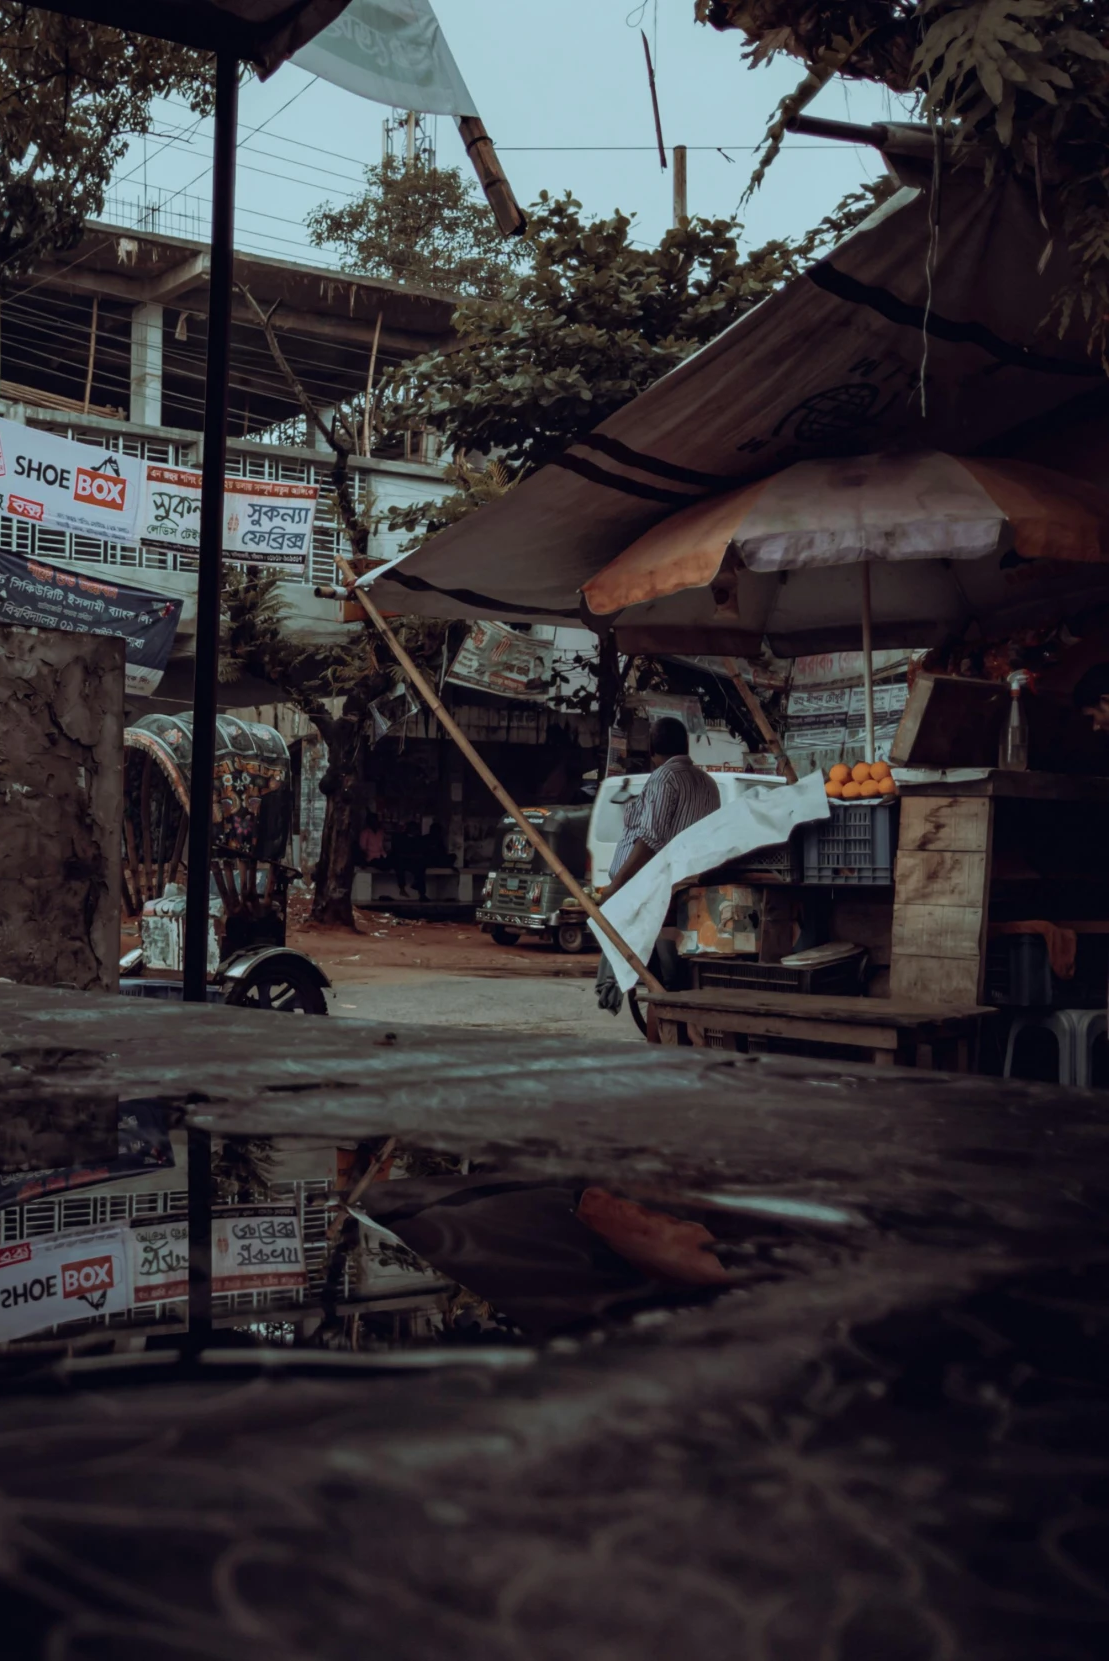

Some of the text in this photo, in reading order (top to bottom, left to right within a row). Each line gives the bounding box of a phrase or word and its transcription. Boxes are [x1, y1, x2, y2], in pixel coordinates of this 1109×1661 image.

[14, 455, 124, 504] SHOE BOX
[248, 503, 311, 528] সুকন্যা
[146, 523, 177, 538] লেডিস
[242, 526, 306, 550] ফেব্রিক্স
[9, 576, 65, 601] সিকিউরিটি
[67, 592, 105, 613] ইসলামী
[108, 605, 136, 620] ব্যাংক
[2, 601, 58, 628] বিশ্ববিদ্যালয়
